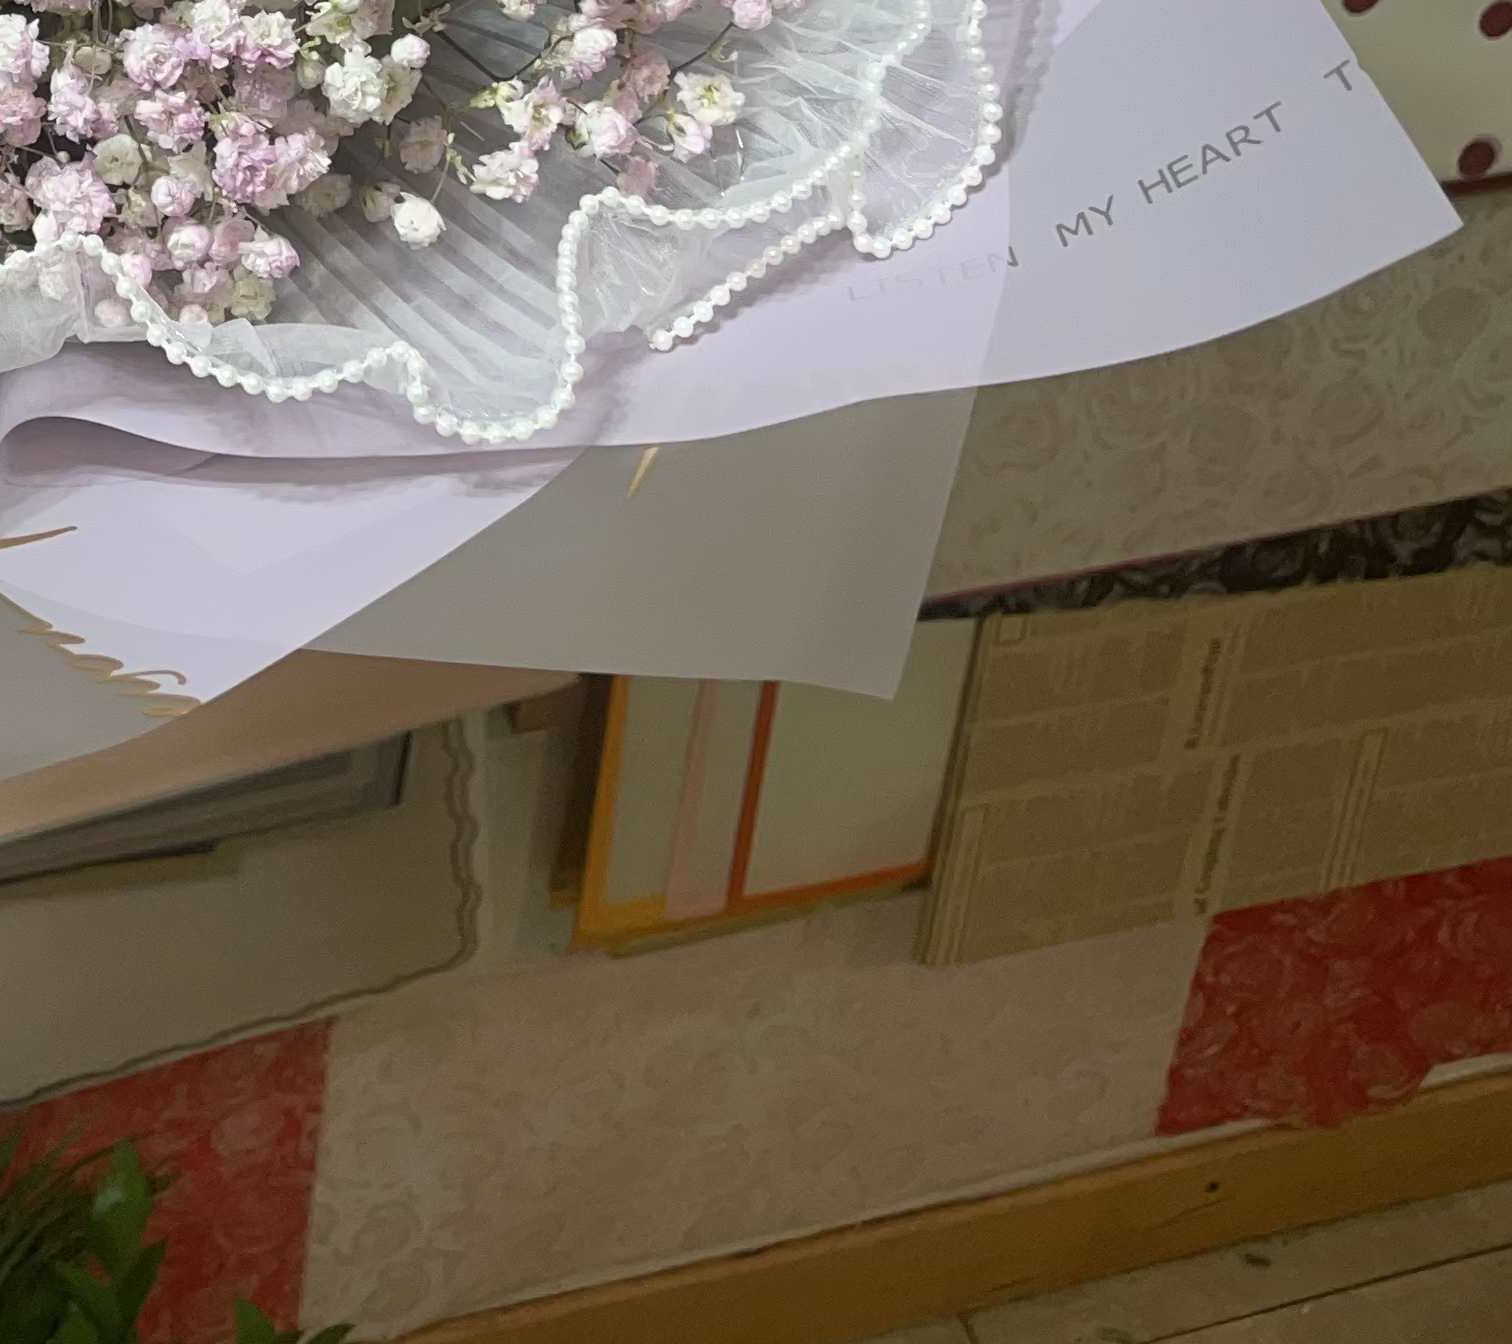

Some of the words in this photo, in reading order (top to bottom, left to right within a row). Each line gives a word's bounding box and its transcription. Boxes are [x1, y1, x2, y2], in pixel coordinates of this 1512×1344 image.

[1055, 194, 1117, 249] MY
[1136, 100, 1285, 206] HEART
[1322, 59, 1355, 93] T
